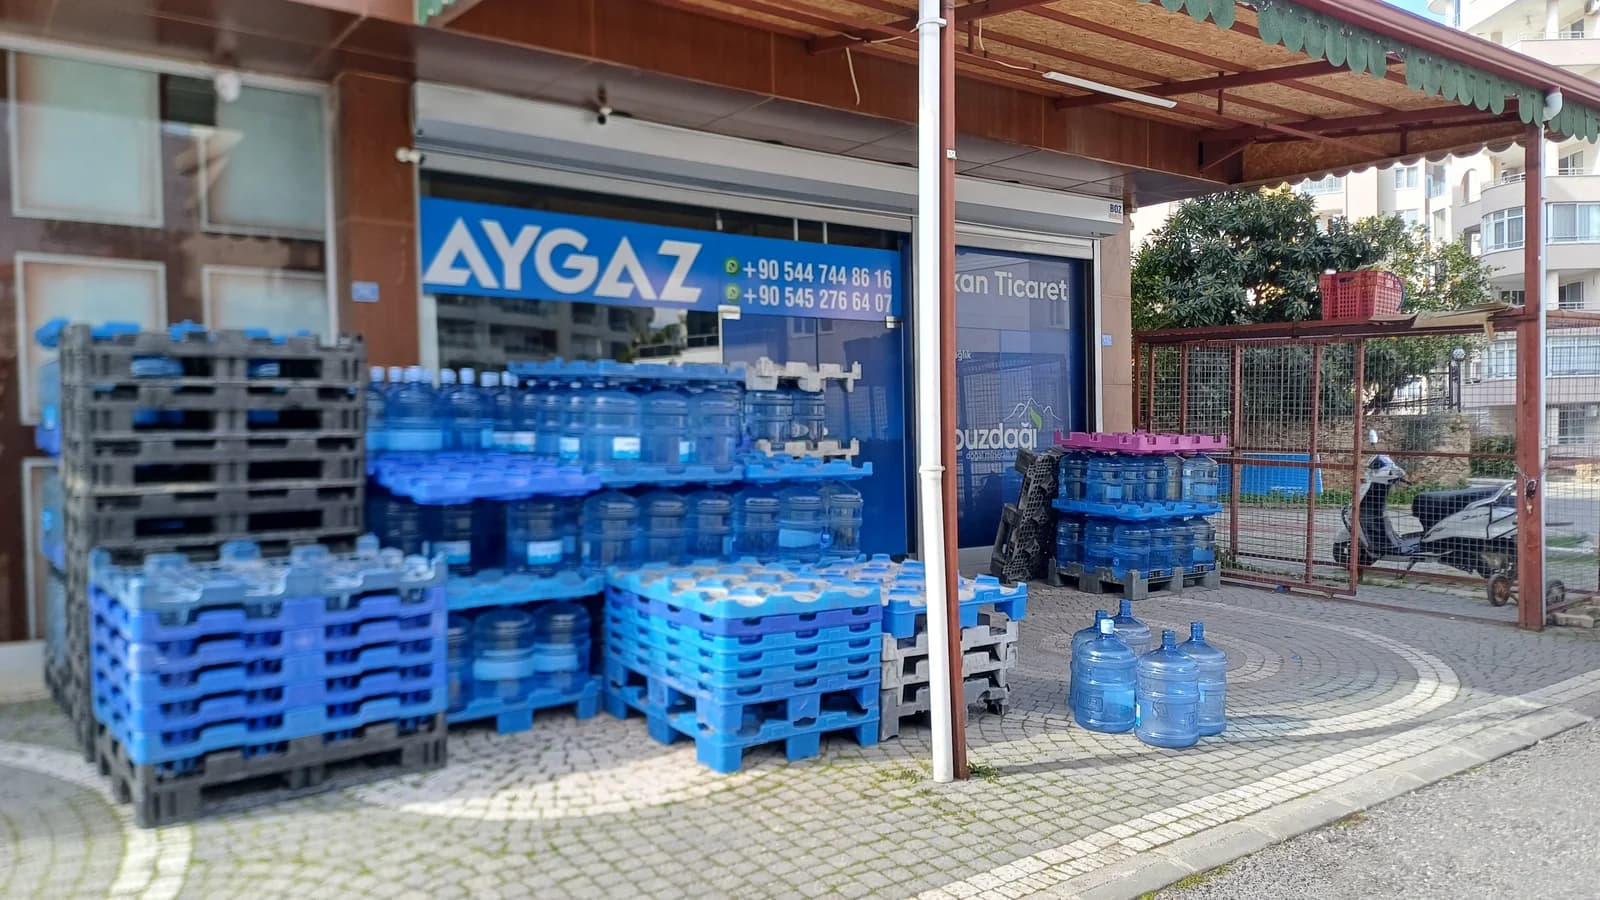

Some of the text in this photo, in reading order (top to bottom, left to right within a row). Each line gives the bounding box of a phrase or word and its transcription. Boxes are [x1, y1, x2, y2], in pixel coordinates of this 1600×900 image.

[423, 217, 703, 303] AYGAZ
[743, 259, 892, 289] +90 544 744 86 16
[743, 285, 893, 313] +90 545 276 64 07
[994, 270, 1067, 301] Ticaret
